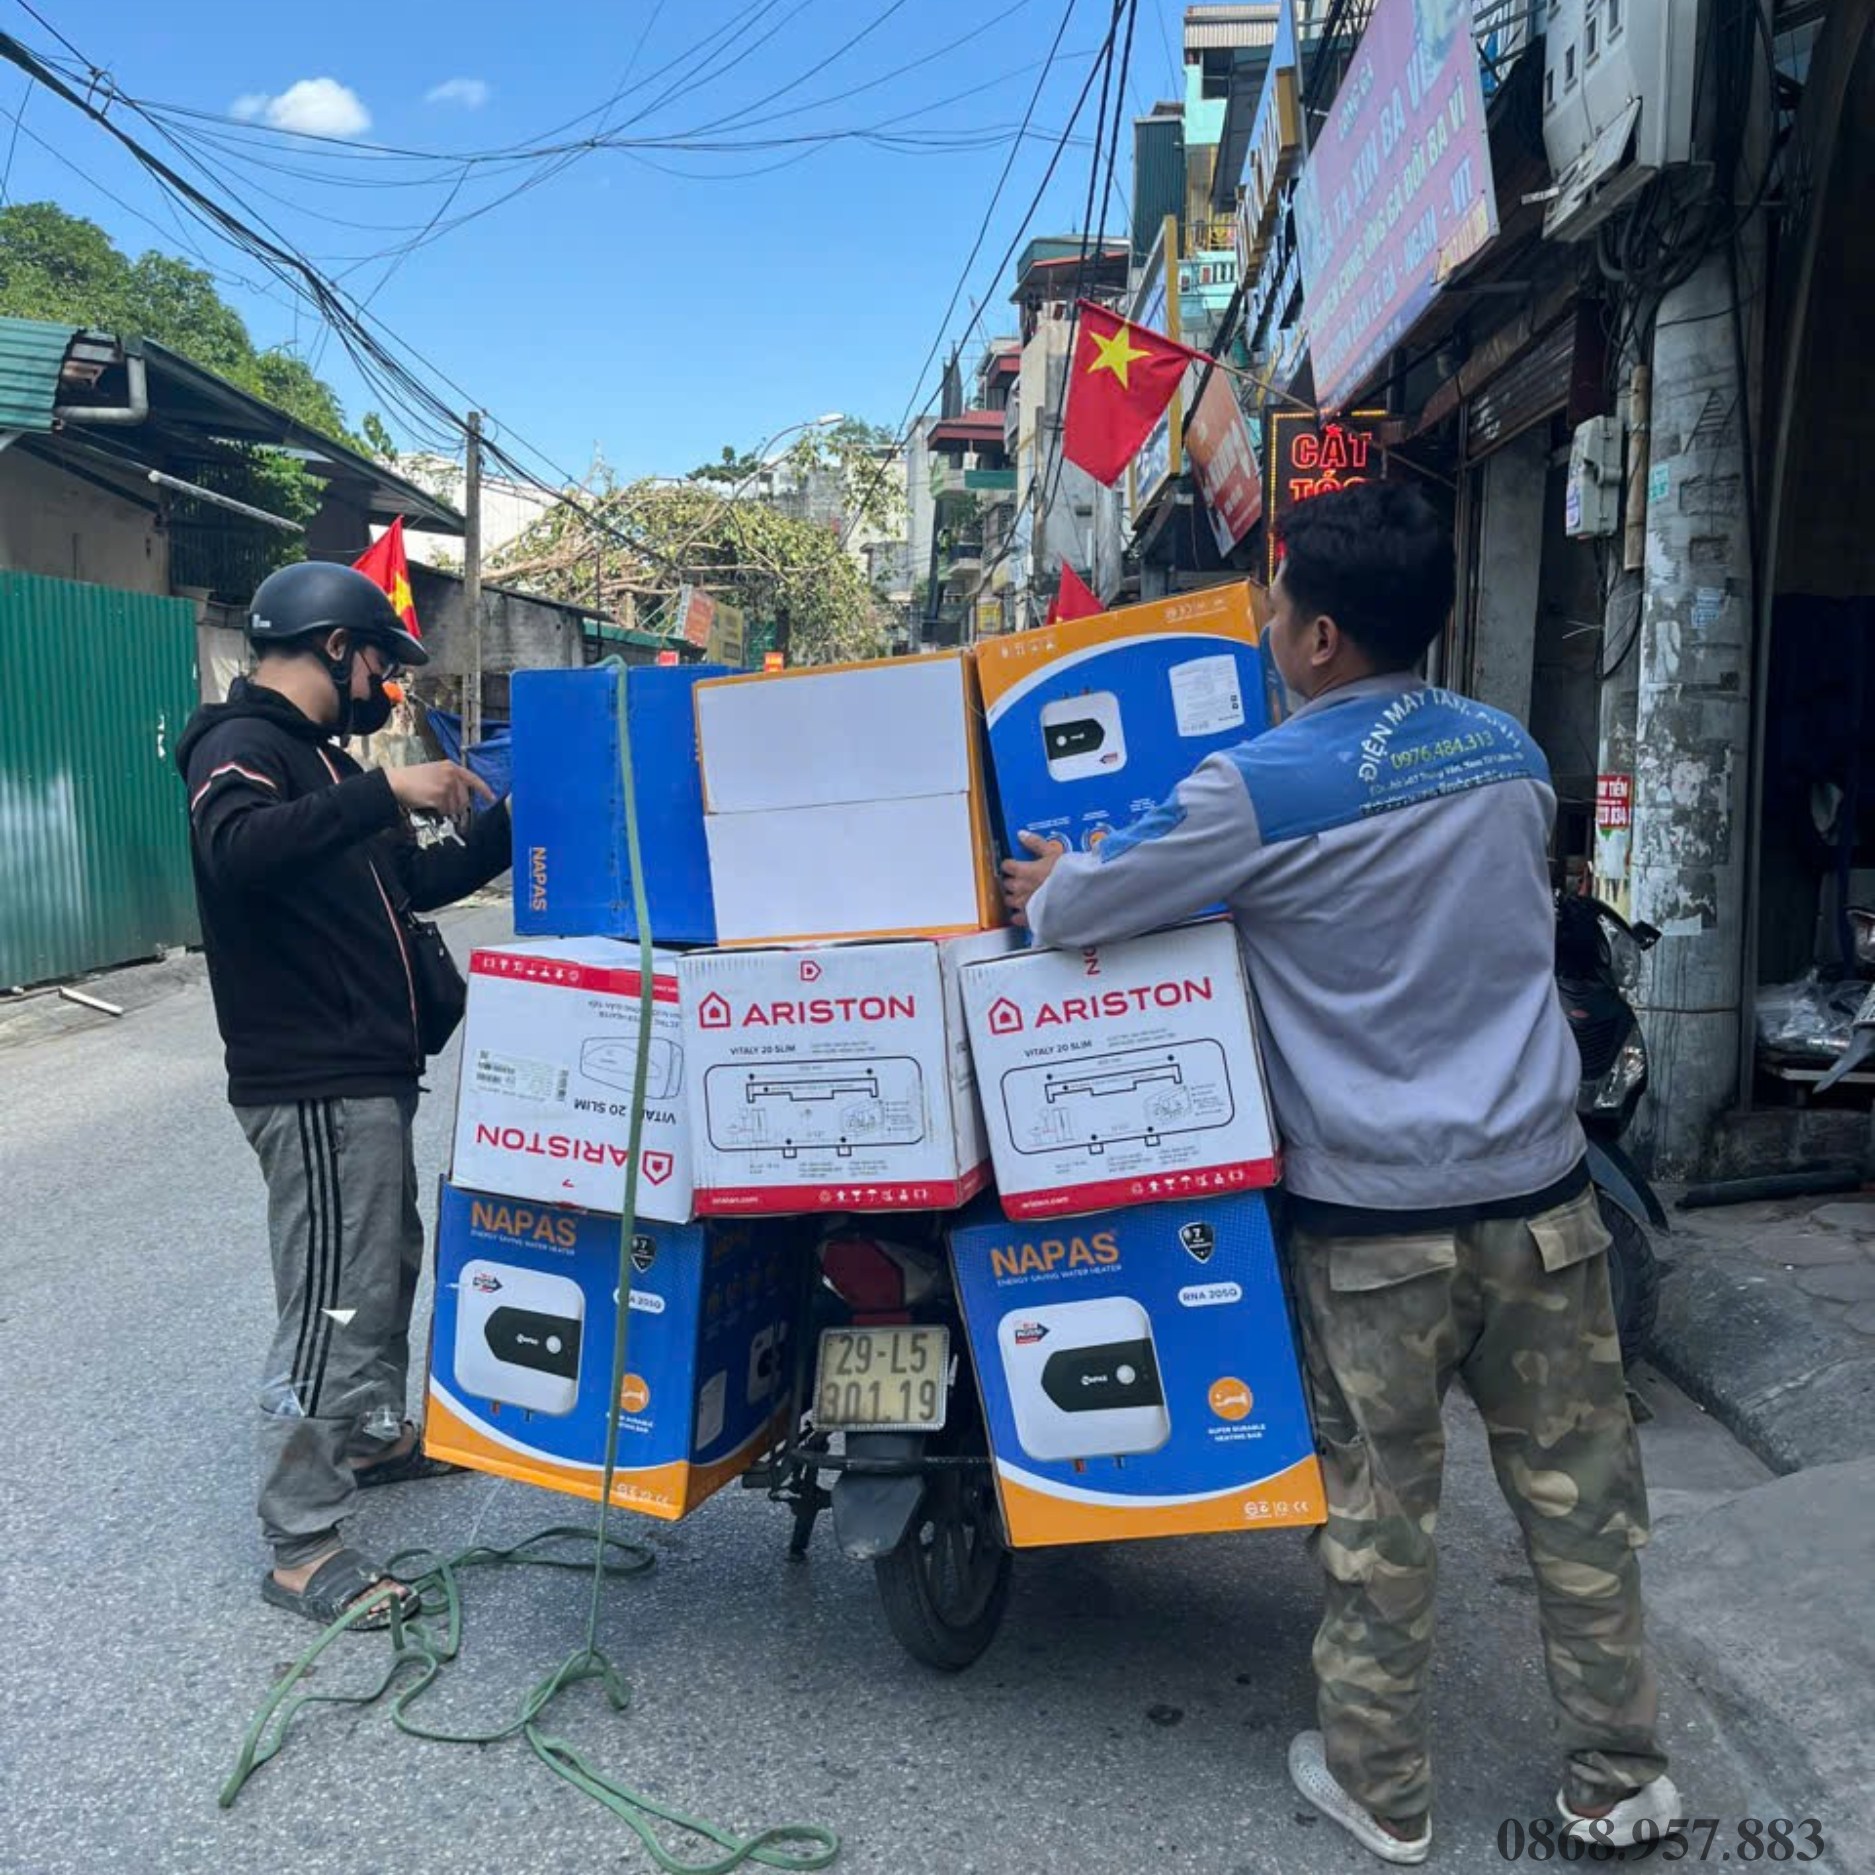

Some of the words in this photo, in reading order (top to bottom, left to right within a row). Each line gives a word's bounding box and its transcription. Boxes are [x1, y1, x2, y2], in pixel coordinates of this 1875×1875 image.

[1380, 85, 1406, 159] BA
[1427, 112, 1448, 168] BA
[1358, 722, 1393, 782] ĐIỆN
[531, 846, 548, 912] NAPAS
[742, 995, 915, 1027] ARISTON
[1035, 977, 1213, 1028] ARISTON
[1024, 1046, 1055, 1059] VITALY
[574, 1098, 607, 1114] SLIM
[476, 1123, 629, 1167] ARISTON
[471, 1201, 577, 1247] NAPAS
[991, 1233, 1120, 1276] NAPAS
[1183, 1289, 1206, 1302] RNA
[836, 1333, 928, 1376] 29-L5
[824, 1380, 937, 1424] 301.19
